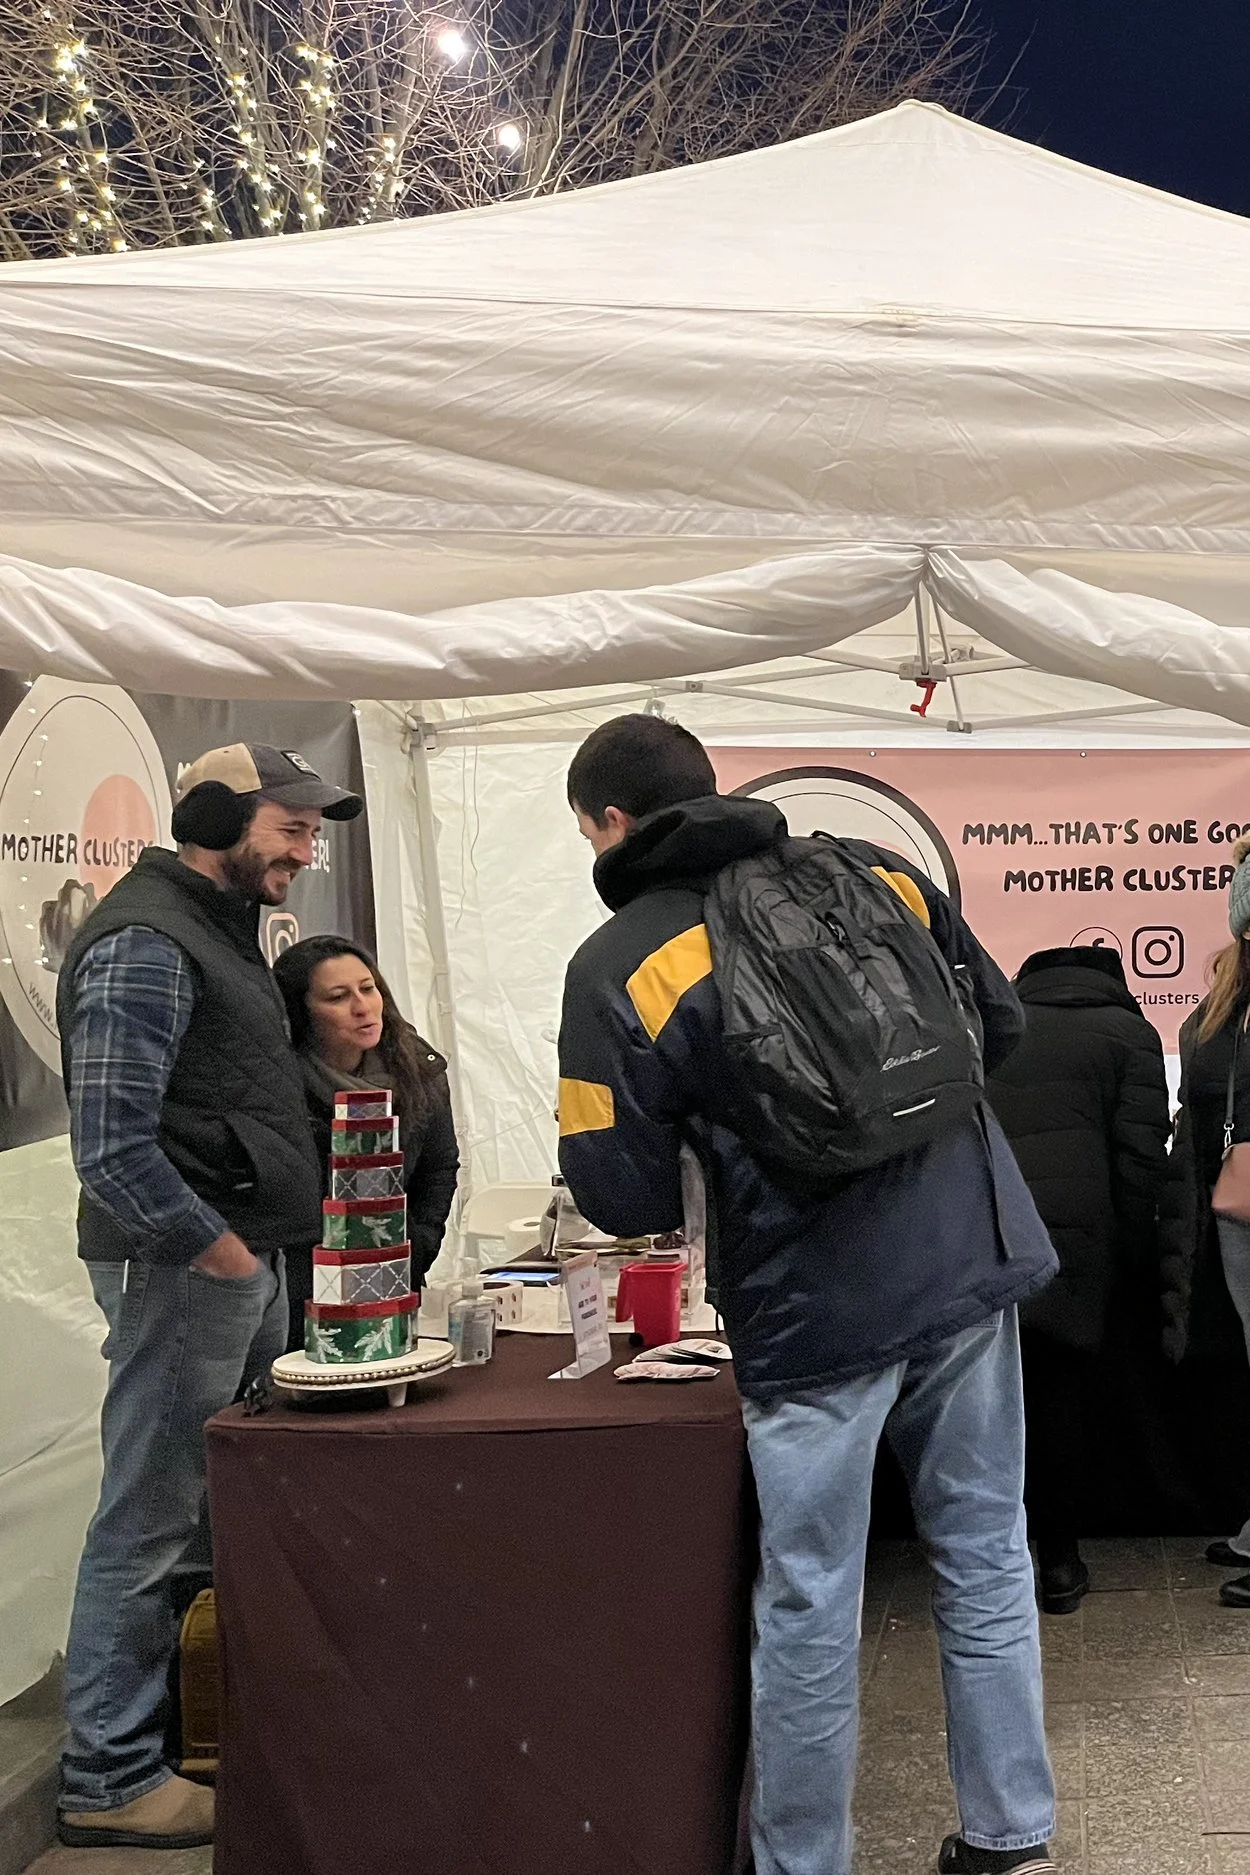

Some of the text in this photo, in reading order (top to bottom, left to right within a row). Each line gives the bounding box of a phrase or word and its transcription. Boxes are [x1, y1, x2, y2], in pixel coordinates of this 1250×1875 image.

[1148, 820, 1199, 844] ONE
[2, 832, 155, 868] MOTHER CLUSTER
[1003, 865, 1114, 893] MOTHER
[1134, 991, 1200, 1005] clusters
